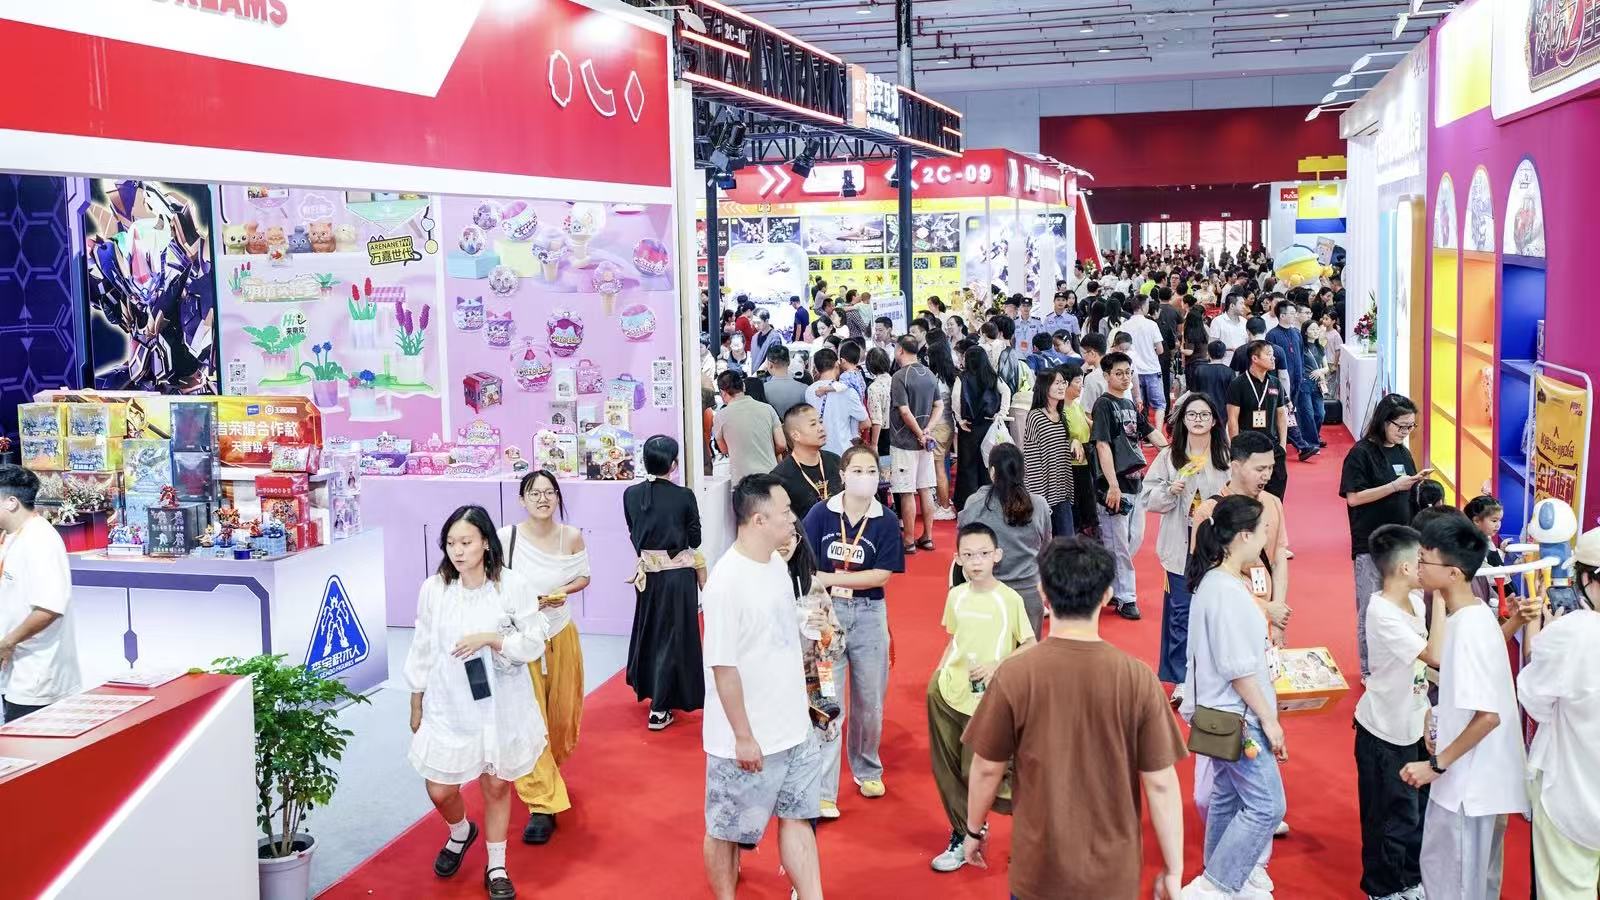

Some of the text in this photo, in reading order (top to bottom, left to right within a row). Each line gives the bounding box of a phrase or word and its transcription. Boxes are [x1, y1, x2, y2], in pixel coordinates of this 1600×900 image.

[724, 22, 746, 45] 2C-10
[922, 164, 992, 184] 2C-09
[372, 247, 412, 263] 万嘉世代
